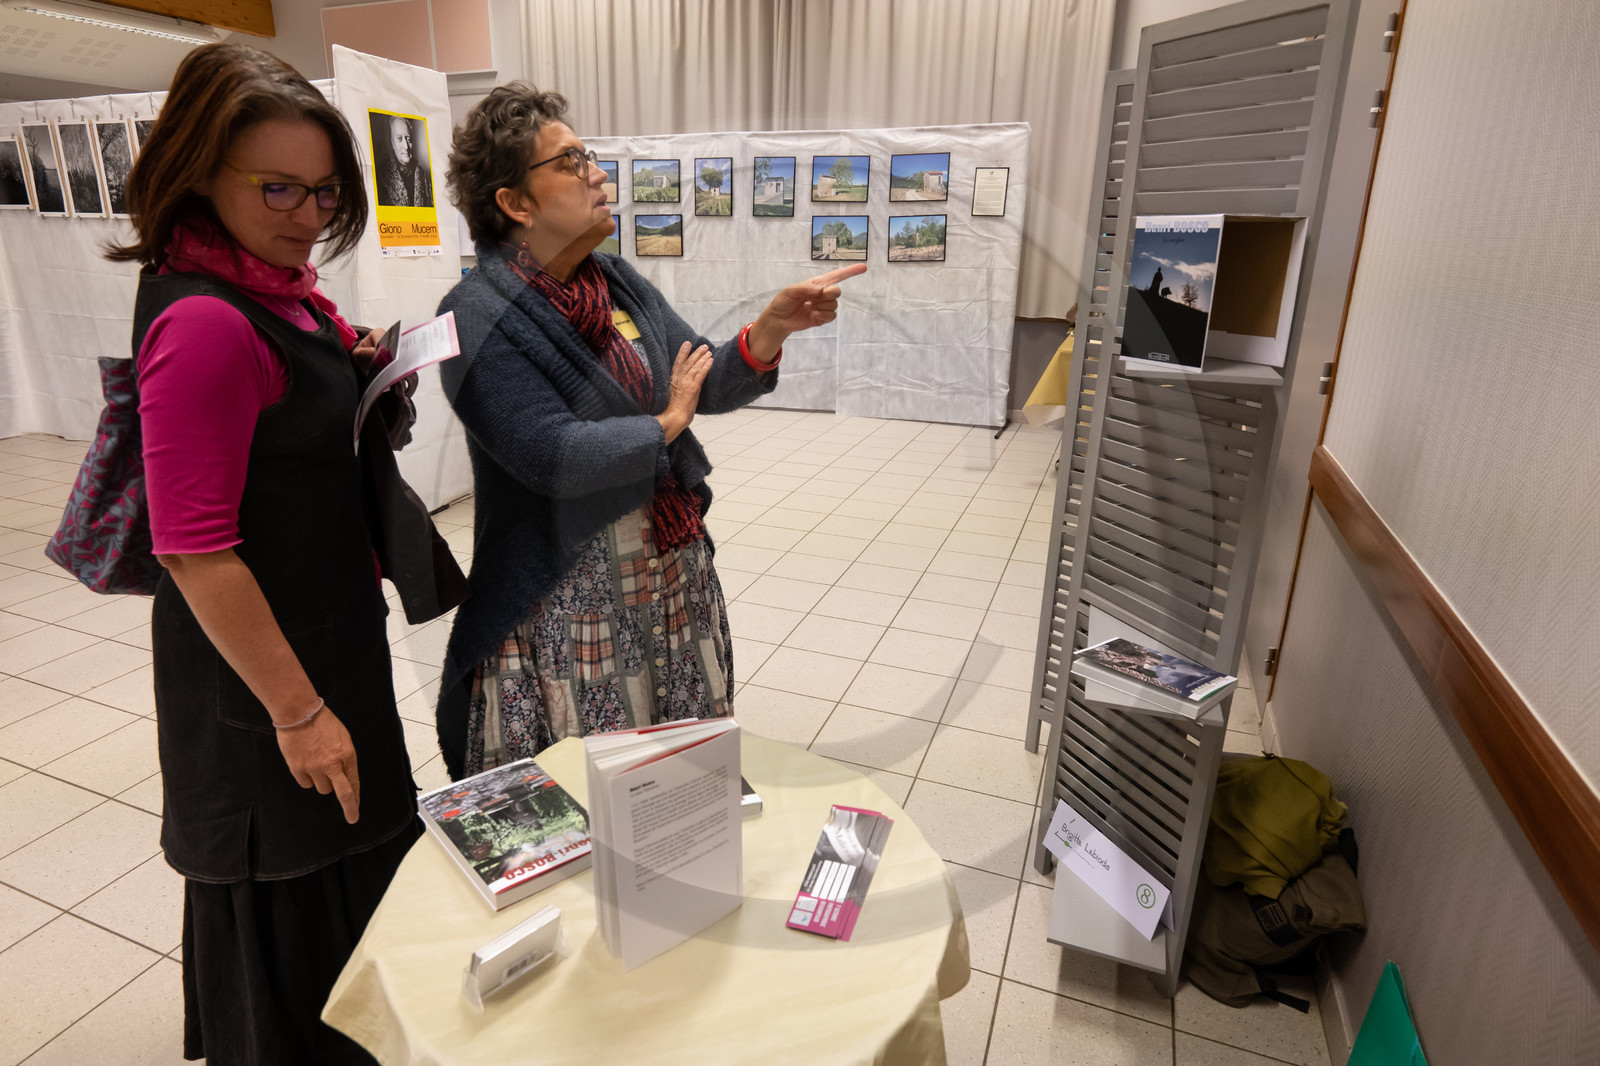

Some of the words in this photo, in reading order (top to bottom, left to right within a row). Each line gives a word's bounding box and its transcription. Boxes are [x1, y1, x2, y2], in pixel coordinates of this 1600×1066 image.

[380, 223, 403, 234] Giono
[411, 223, 437, 234] Mucem
[1144, 220, 1171, 233] Henri
[1173, 220, 1209, 234] BOSCO
[503, 852, 557, 880] BOSCO
[1140, 888, 1152, 905] 8
